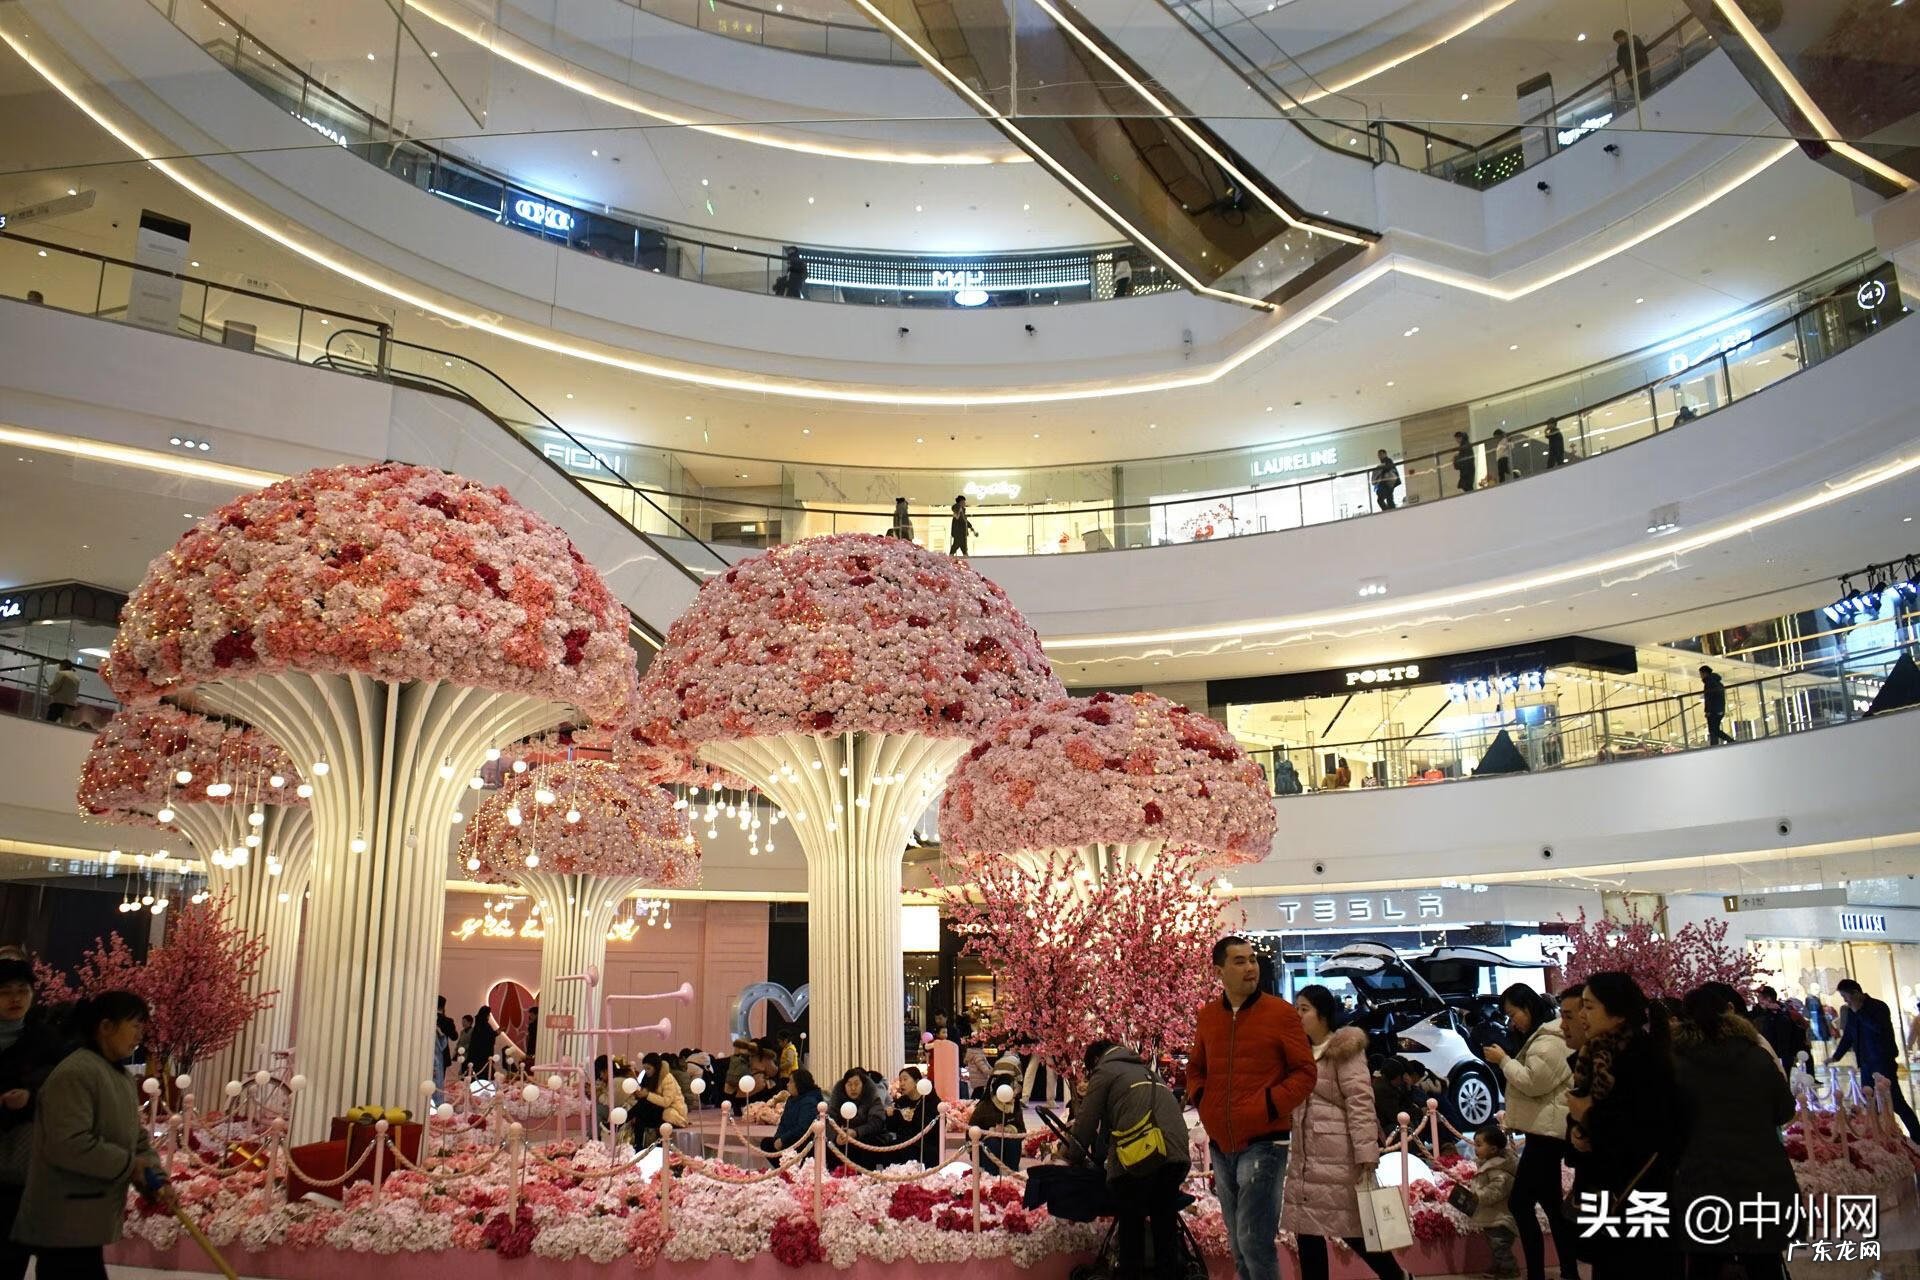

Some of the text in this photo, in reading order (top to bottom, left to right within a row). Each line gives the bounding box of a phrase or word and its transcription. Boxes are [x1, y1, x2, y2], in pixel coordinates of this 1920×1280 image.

[543, 443, 621, 474] FION
[1253, 447, 1338, 477] LAURELINE
[1345, 664, 1420, 686] PORTS
[1277, 894, 1443, 924] TESLA
